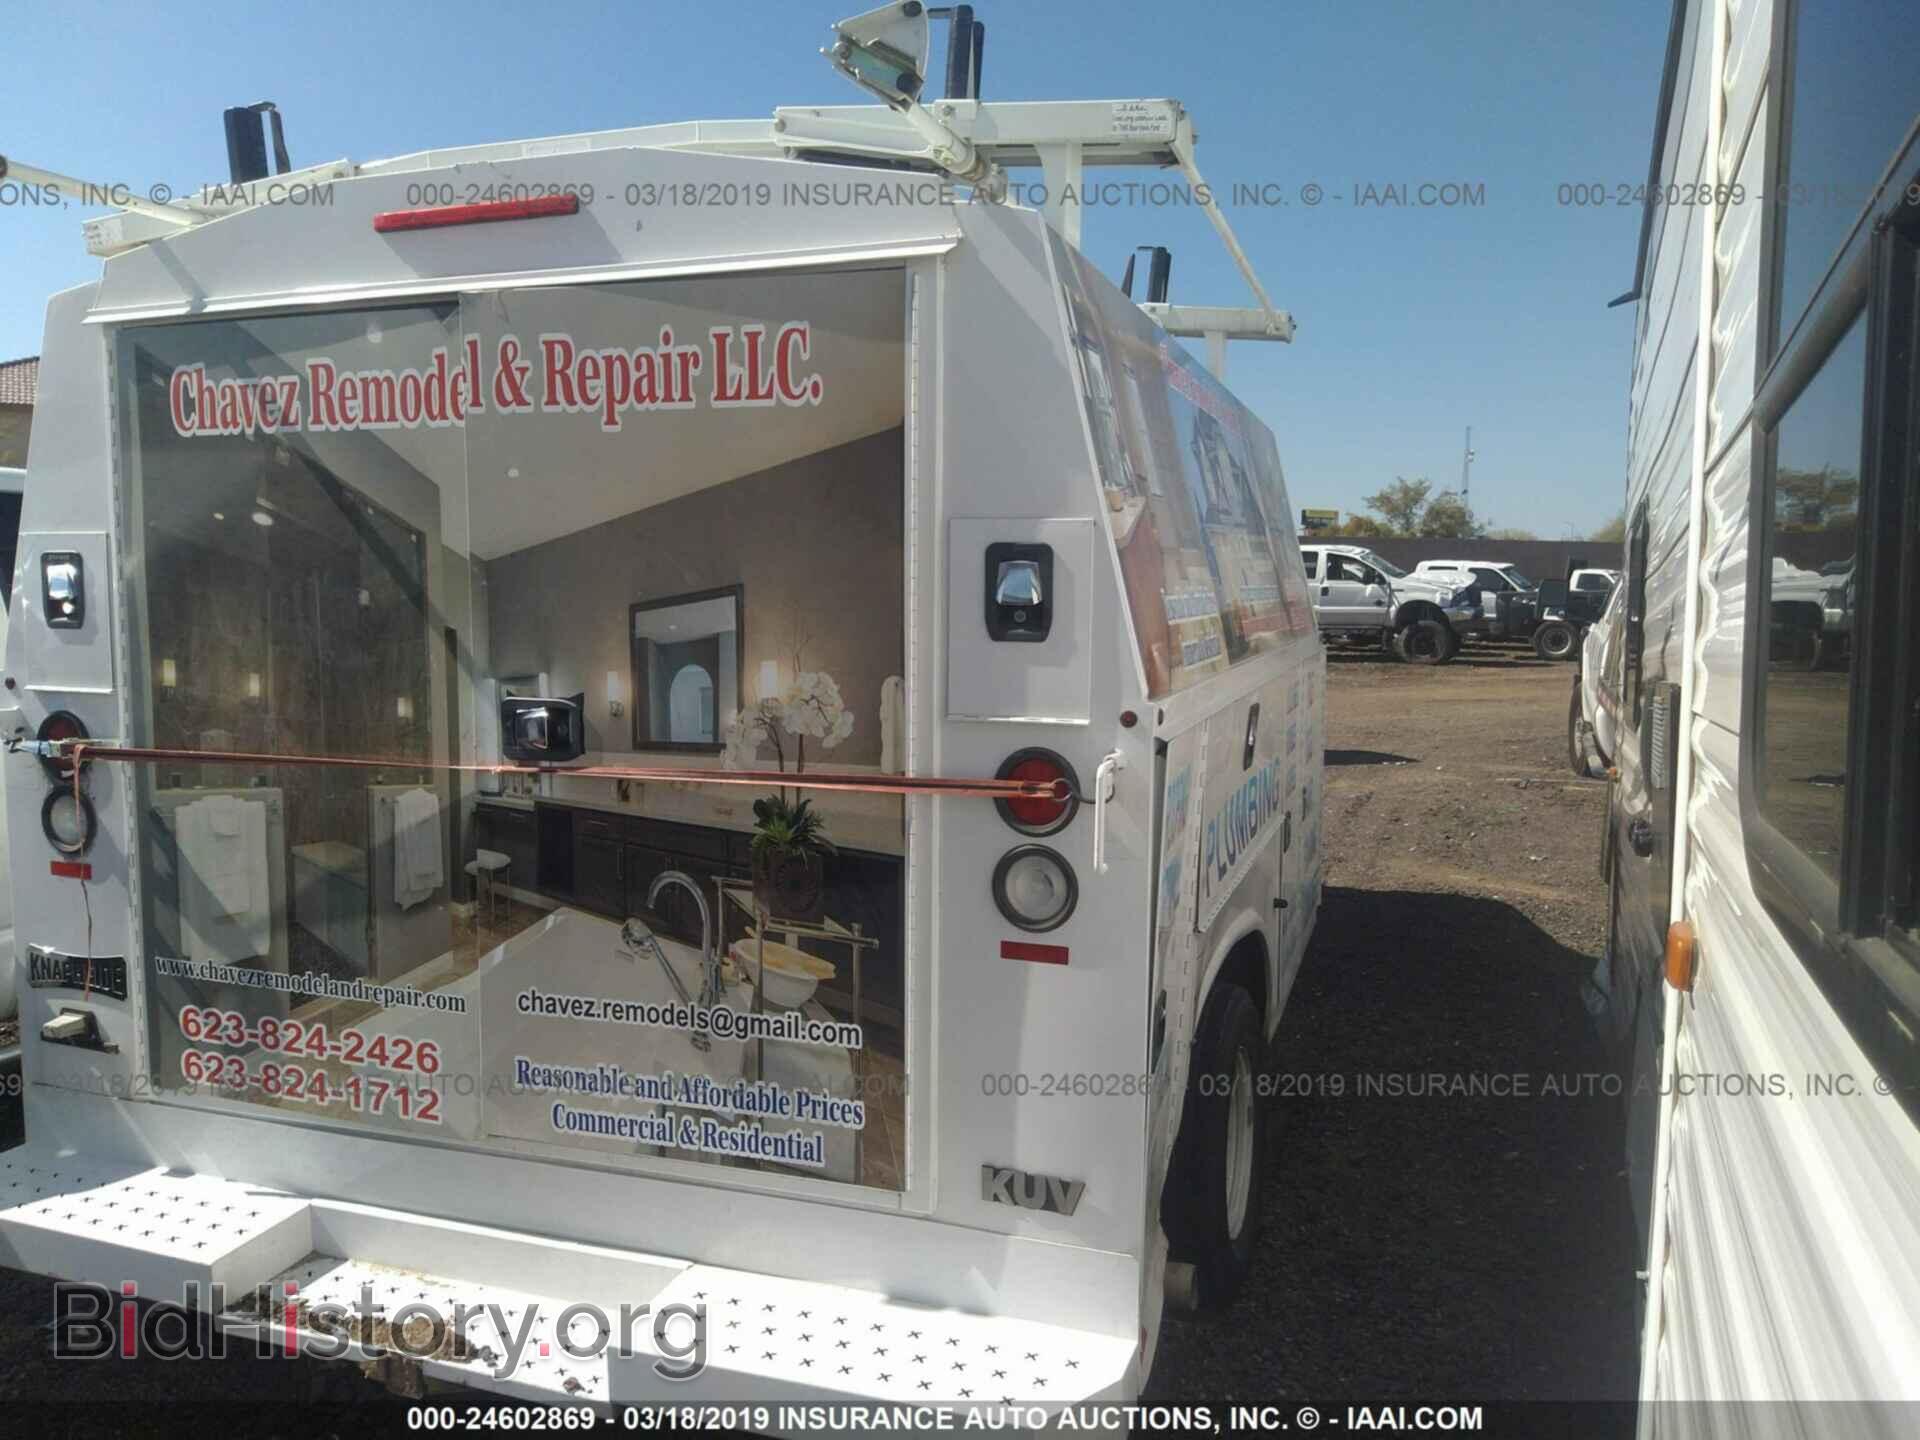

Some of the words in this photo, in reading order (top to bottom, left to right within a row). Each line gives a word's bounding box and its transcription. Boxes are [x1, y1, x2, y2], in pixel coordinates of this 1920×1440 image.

[170, 363, 301, 437] Chavez
[305, 334, 484, 431] Remodel
[493, 336, 533, 411] &
[540, 326, 700, 430] Repair
[710, 323, 823, 407] LLC.
[155, 957, 467, 1013] www.chavezremodelandrepair.com
[517, 988, 864, 1047] chavez.remodels@gmail.com
[181, 1006, 441, 1075] 623-824-2426
[182, 1050, 442, 1122] 623-824-1712
[515, 1058, 631, 1097] Reasonable
[634, 1074, 674, 1103] and
[677, 1076, 791, 1117] Affordable
[795, 1090, 865, 1127] Prices
[552, 1102, 674, 1144] Commercial
[679, 1118, 700, 1147] &
[702, 1118, 824, 1163] Residential
[981, 1164, 1086, 1216] KUV
